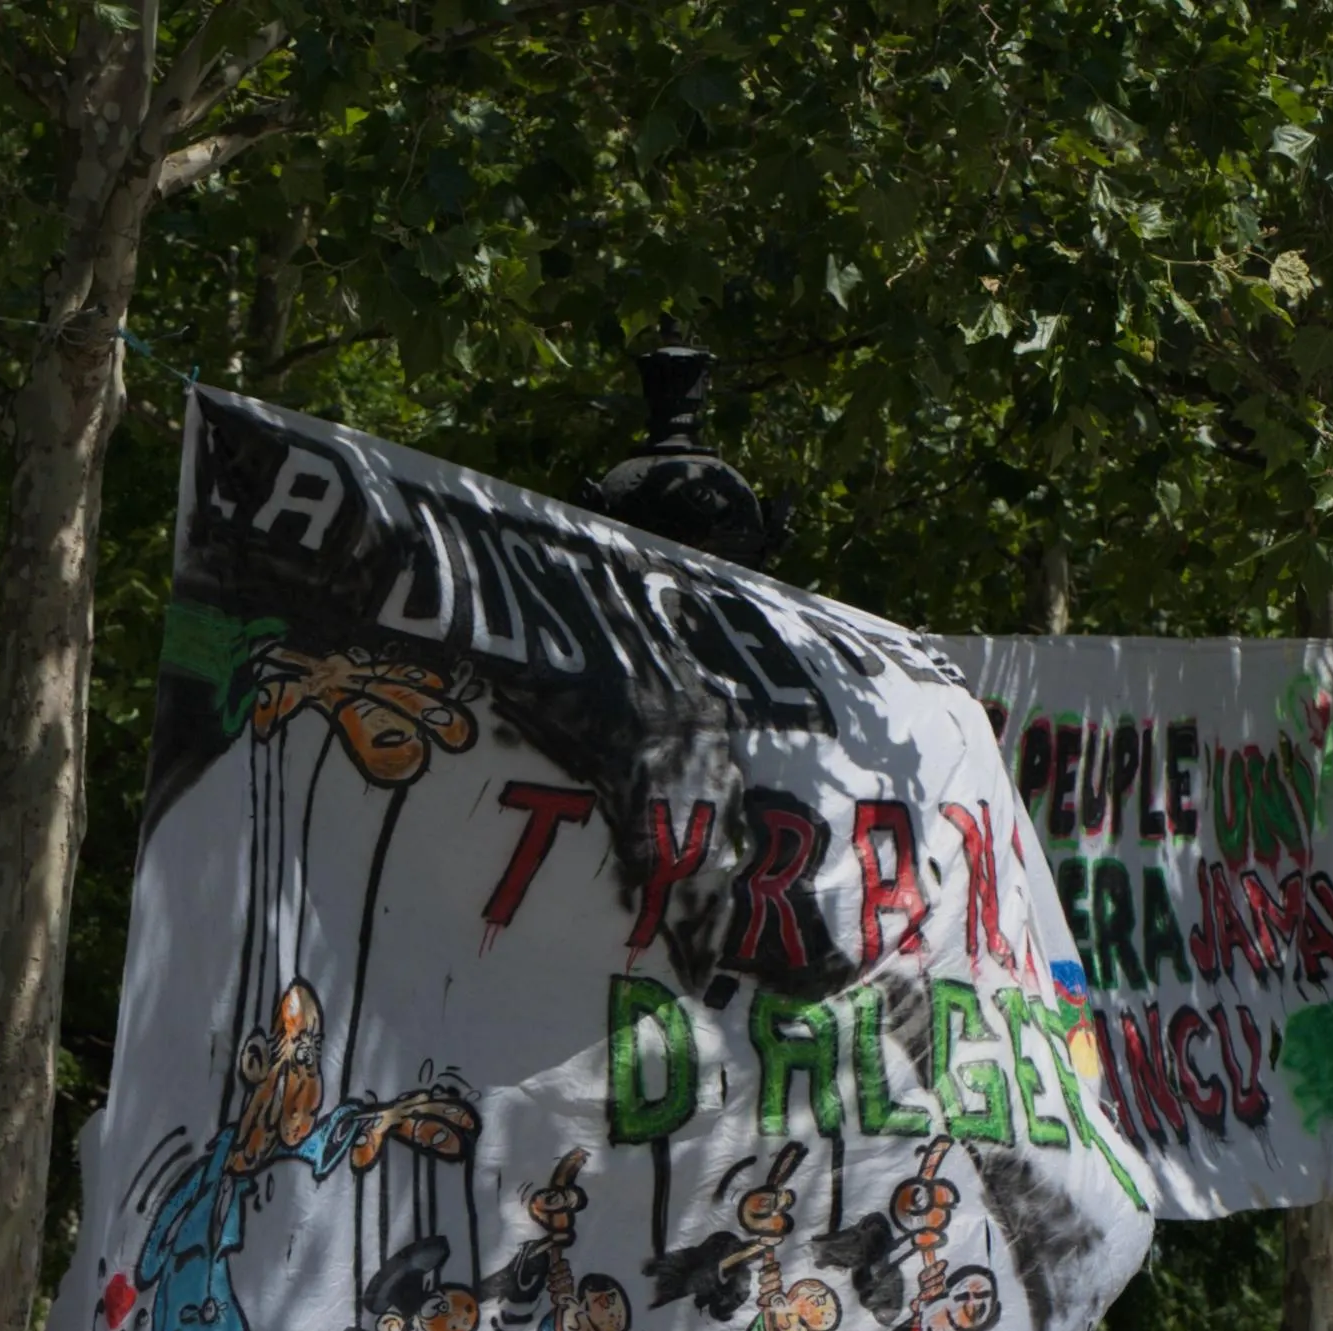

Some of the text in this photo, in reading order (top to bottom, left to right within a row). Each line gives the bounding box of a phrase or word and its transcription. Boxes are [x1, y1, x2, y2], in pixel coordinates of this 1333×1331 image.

[378, 495, 811, 712] JUSTICE
[1017, 712, 1200, 842] PEUPLE
[481, 779, 1041, 970] TYRAN
[1057, 855, 1194, 990] ERA
[1093, 1000, 1270, 1155] INCU
